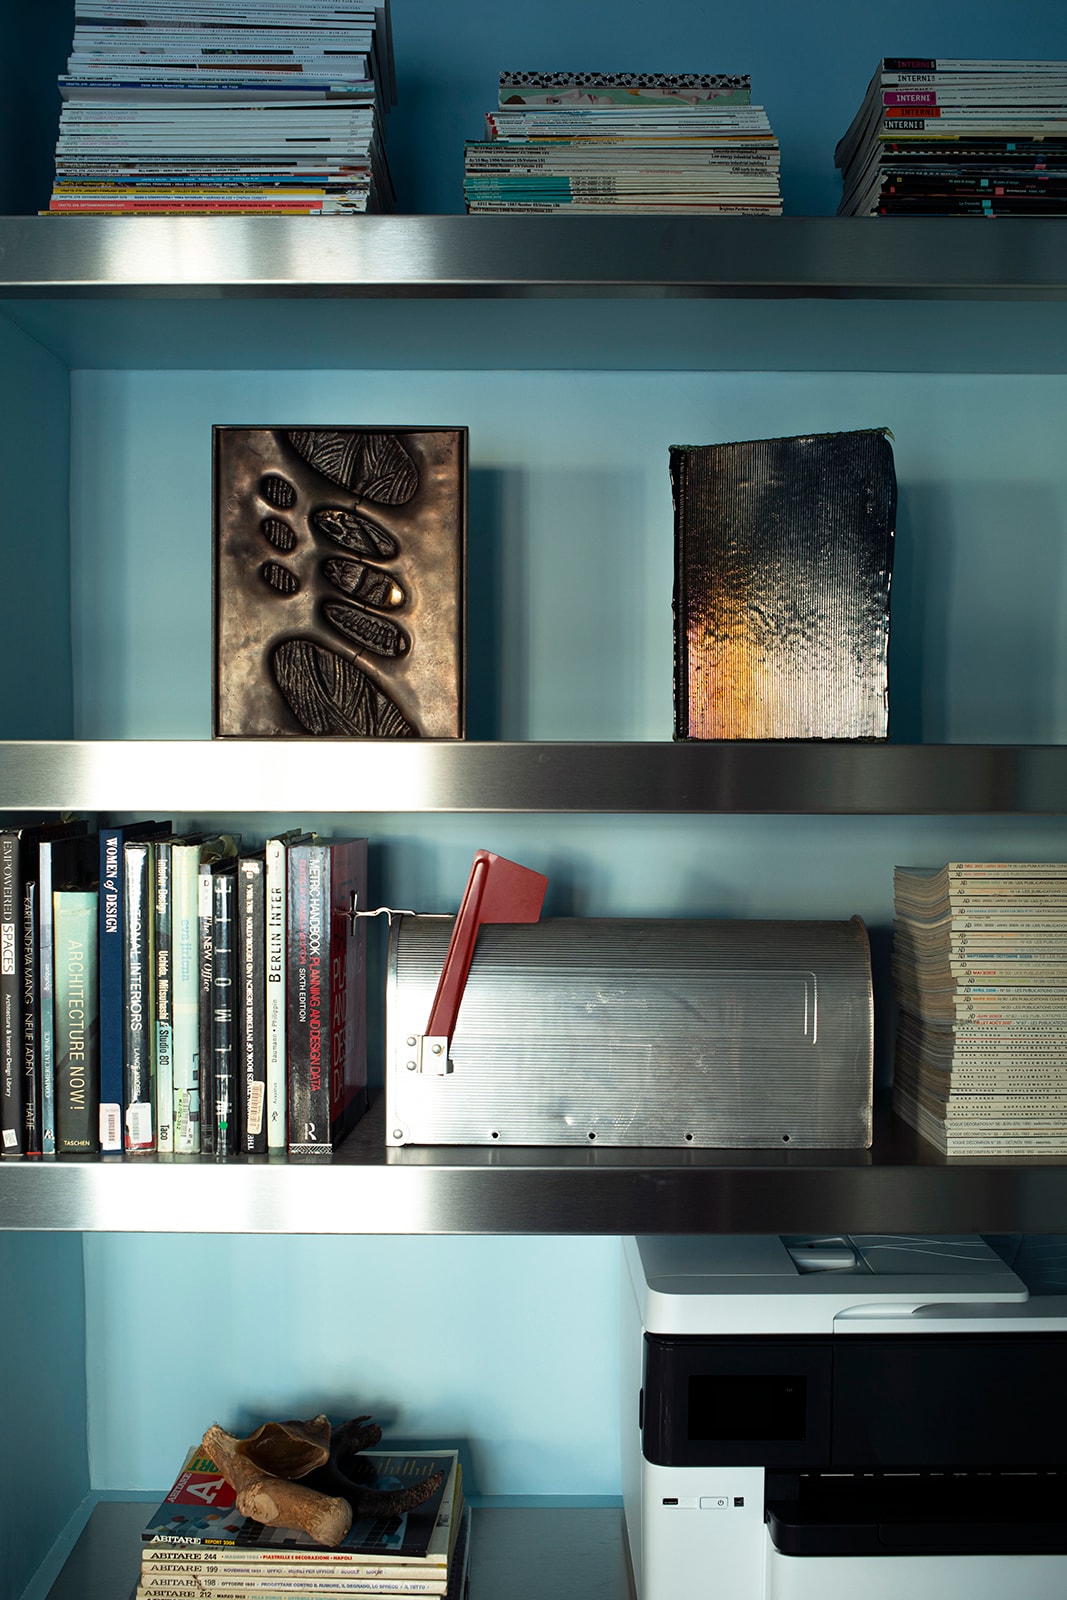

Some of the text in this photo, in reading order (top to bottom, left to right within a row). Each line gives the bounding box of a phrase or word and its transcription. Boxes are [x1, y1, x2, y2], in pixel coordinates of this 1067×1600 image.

[884, 121, 918, 129] INTERNI
[104, 837, 118, 932] WOMEN of DESIGN
[156, 859, 168, 914] Interior Design
[300, 887, 306, 897] BY
[2, 841, 14, 974] EMPOWERED SPACES
[204, 936, 212, 961] NEW
[246, 916, 254, 962] DECORATION
[158, 950, 168, 977] Uchida,
[246, 962, 254, 978] AND
[268, 932, 282, 982] BERLIN
[24, 967, 33, 1004] MANG
[201, 963, 212, 992] Office
[309, 859, 320, 1091] METRIC HANDBOOK PLANNING AND DESIGN DATA
[130, 962, 142, 1031] INTERIORS
[158, 980, 168, 1020] Mitsuhashi
[246, 979, 254, 1006] DESIGN
[298, 968, 306, 1022] SIXTH EDITION
[68, 940, 85, 1110] ARCHITECTURE NOW!
[246, 1007, 254, 1042] INTERIOR
[160, 1030, 169, 1053] Studio
[4, 1058, 12, 1077] Design
[160, 1055, 169, 1066] 80
[246, 1052, 254, 1072] BOOK
[4, 1078, 12, 1097] Library
[160, 1124, 170, 1140] Taco
[246, 1134, 254, 1150] THE
[167, 1472, 192, 1504] ABITARE
[151, 1536, 202, 1545] ABITARE
[150, 1552, 202, 1560] ABITARE
[150, 1564, 202, 1572] ABITARE
[144, 1590, 195, 1598] ABITARE
[204, 1579, 216, 1587] 198
